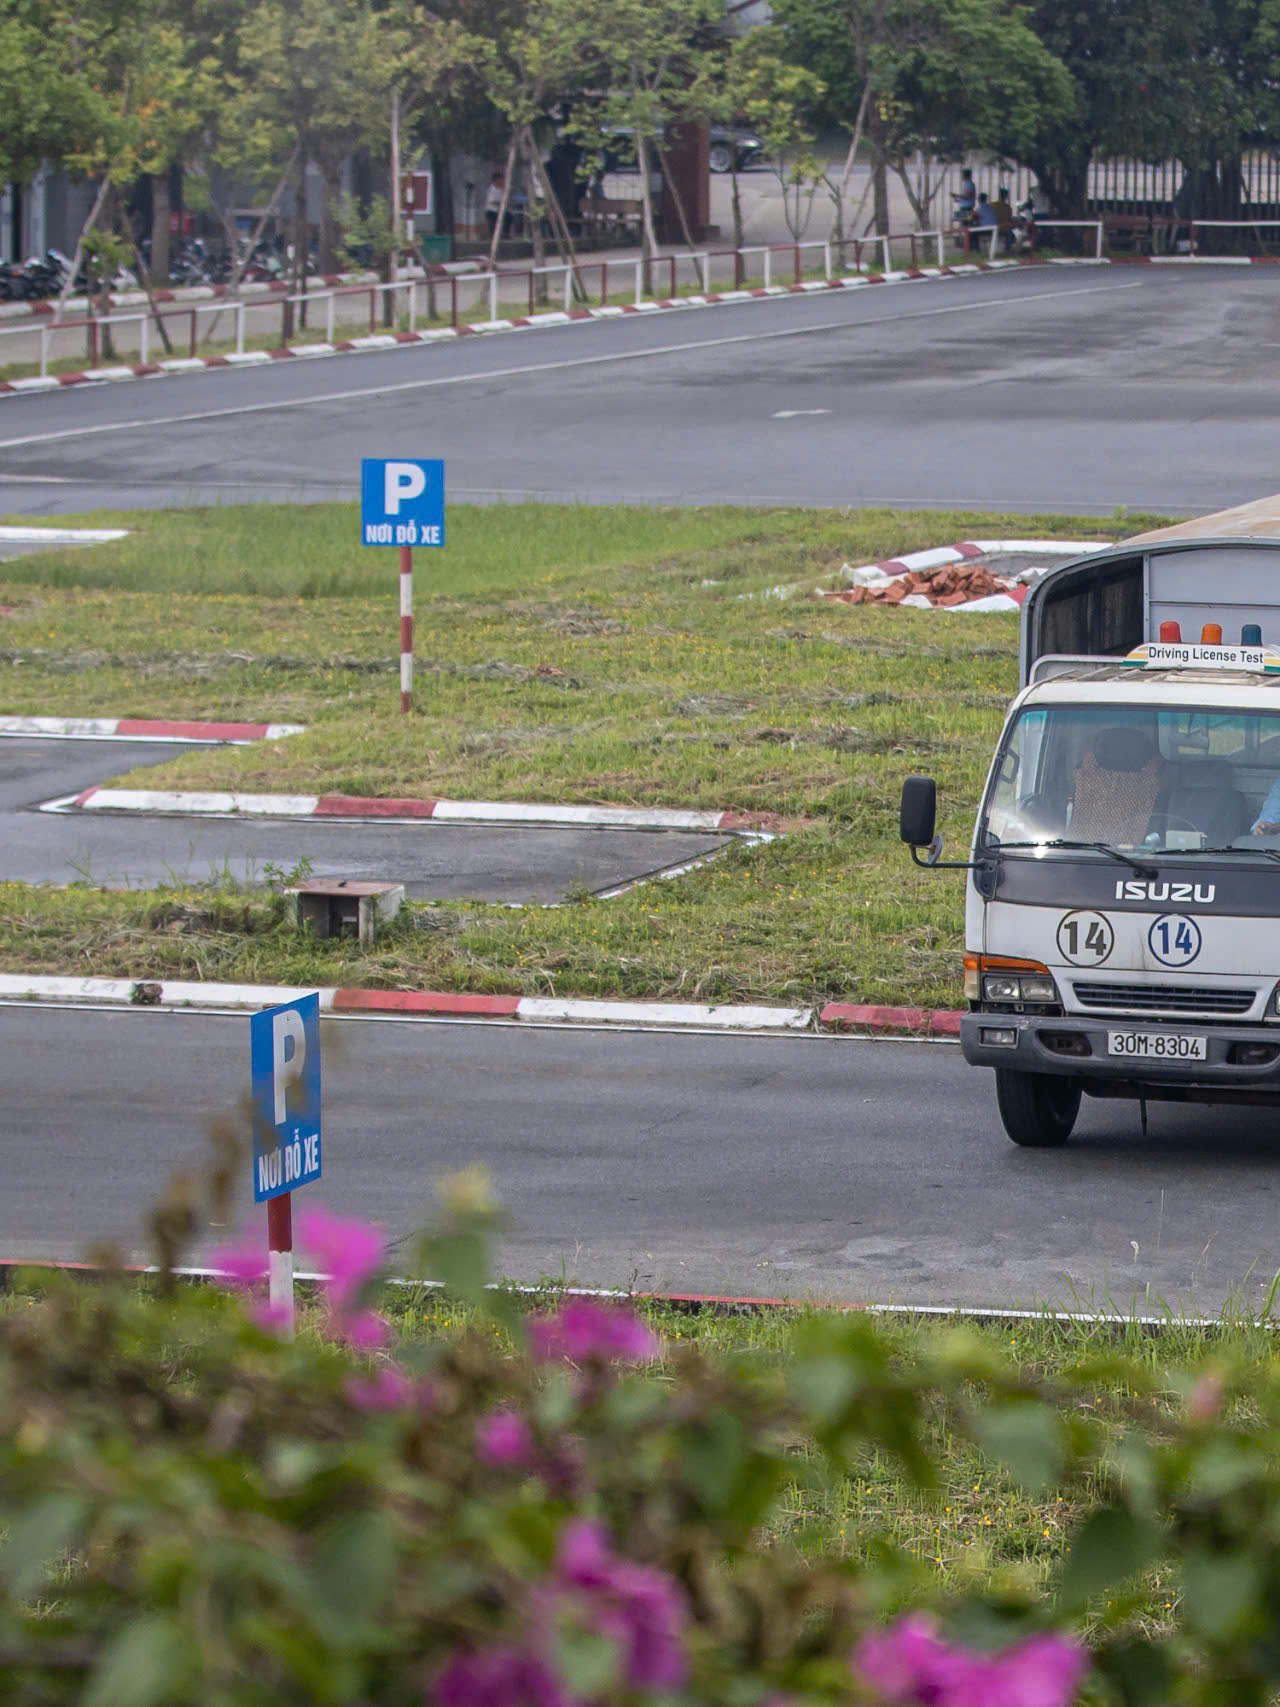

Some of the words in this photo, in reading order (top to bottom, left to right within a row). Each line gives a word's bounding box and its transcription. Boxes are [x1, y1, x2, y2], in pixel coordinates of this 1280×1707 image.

[384, 462, 426, 515] P
[365, 522, 393, 544] NƠI
[421, 525, 440, 544] XE
[1148, 646, 1189, 661] Driving
[1192, 647, 1237, 662] License
[1240, 650, 1264, 664] Test
[1115, 880, 1216, 903] ISUZU
[1063, 920, 1107, 956] 14
[1156, 921, 1194, 955] 14
[1113, 1034, 1201, 1057] 30M-8304
[272, 1009, 307, 1126] P
[258, 1149, 282, 1193] NƠI
[285, 1128, 302, 1184] ĐỖ
[303, 1133, 319, 1176] XE
